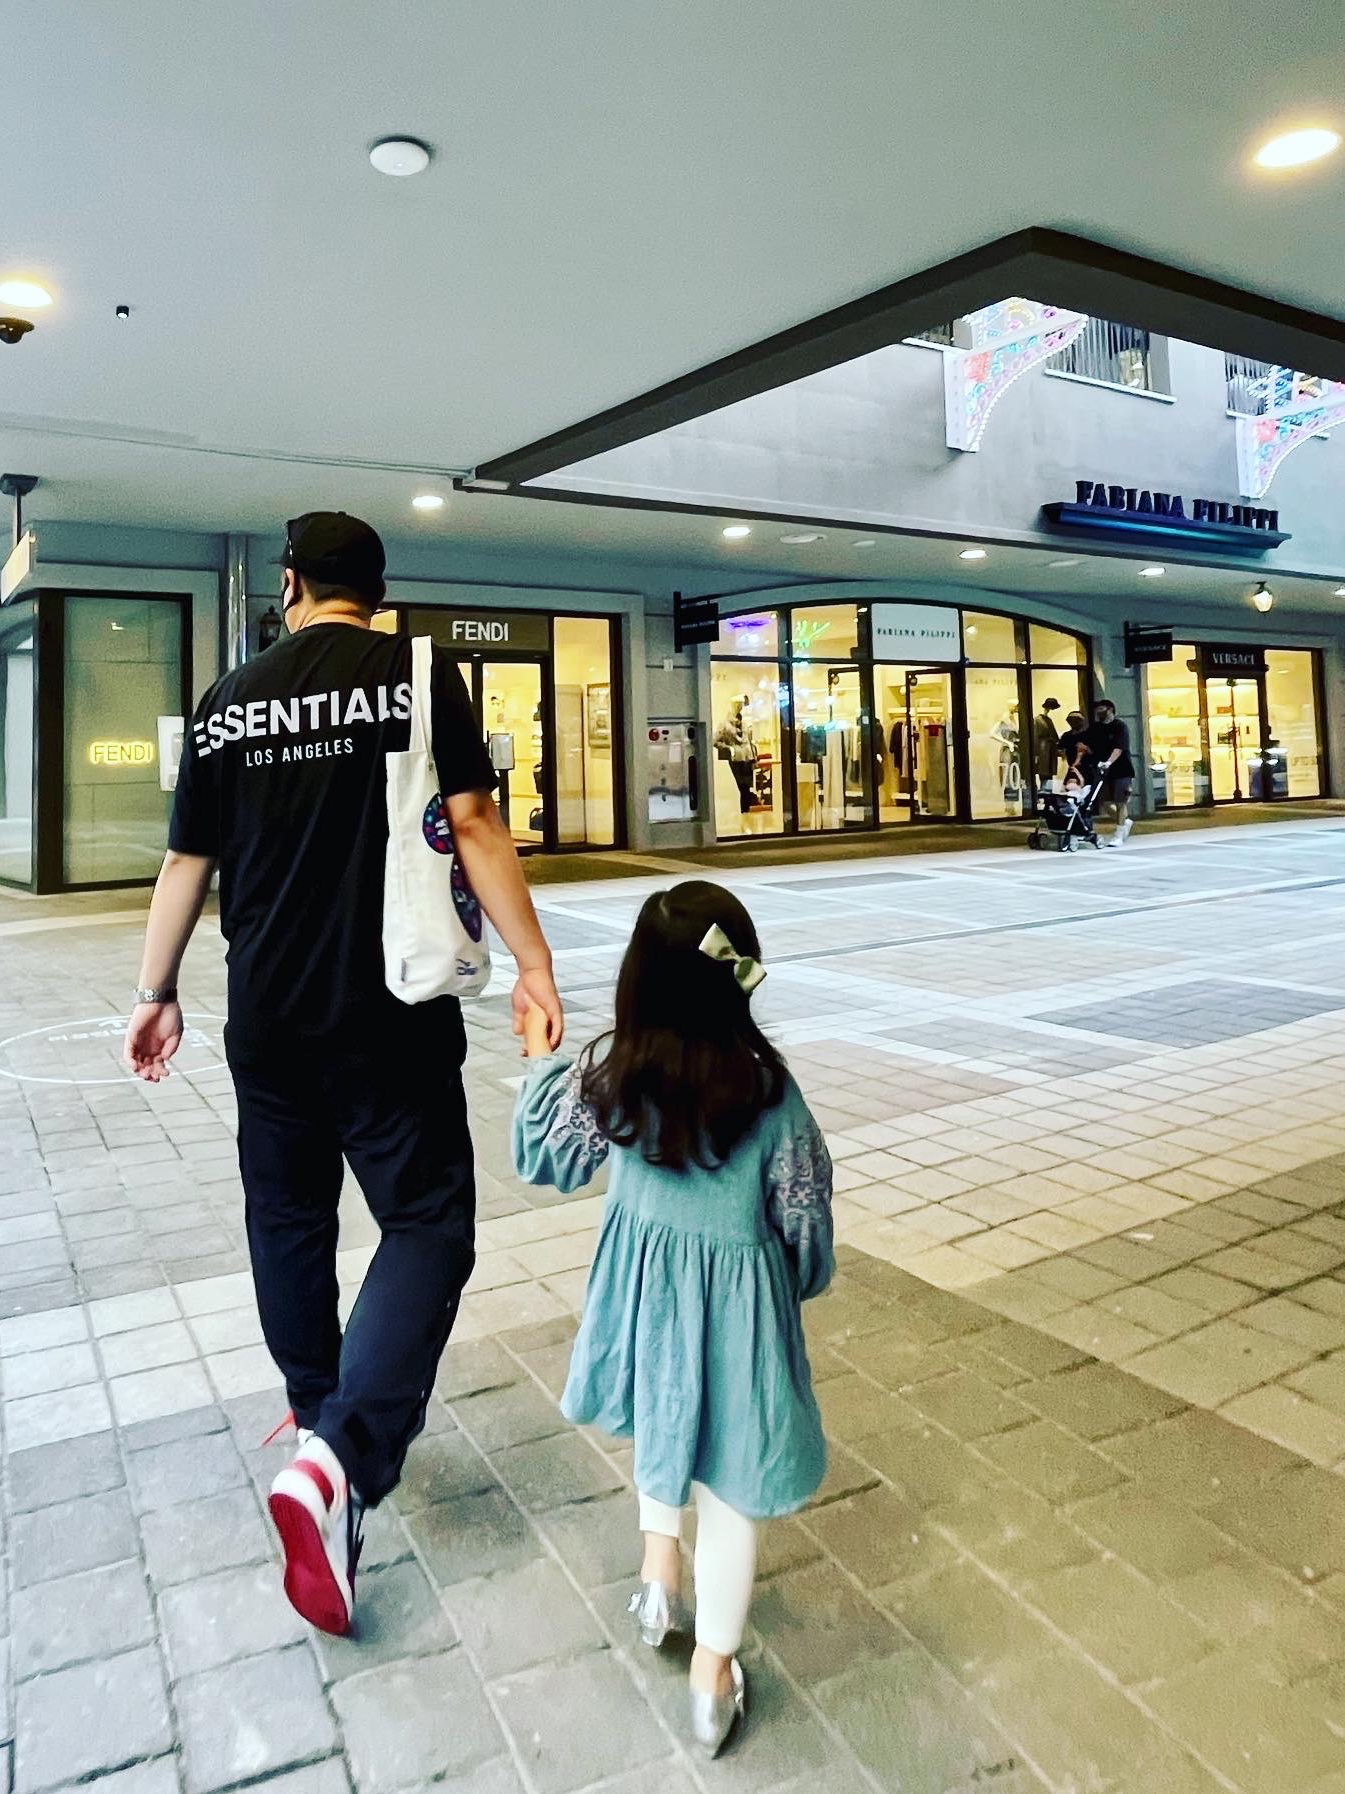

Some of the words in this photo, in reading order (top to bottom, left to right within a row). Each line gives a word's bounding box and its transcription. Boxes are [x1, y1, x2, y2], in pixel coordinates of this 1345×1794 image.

[1075, 480, 1185, 519] FABIANA
[451, 620, 509, 642] FENDI
[1212, 652, 1254, 665] VERSACE
[193, 682, 412, 757] ESSENTIALS
[93, 744, 152, 762] FENDI
[246, 749, 273, 767] LOS
[282, 737, 354, 763] ANGELES
